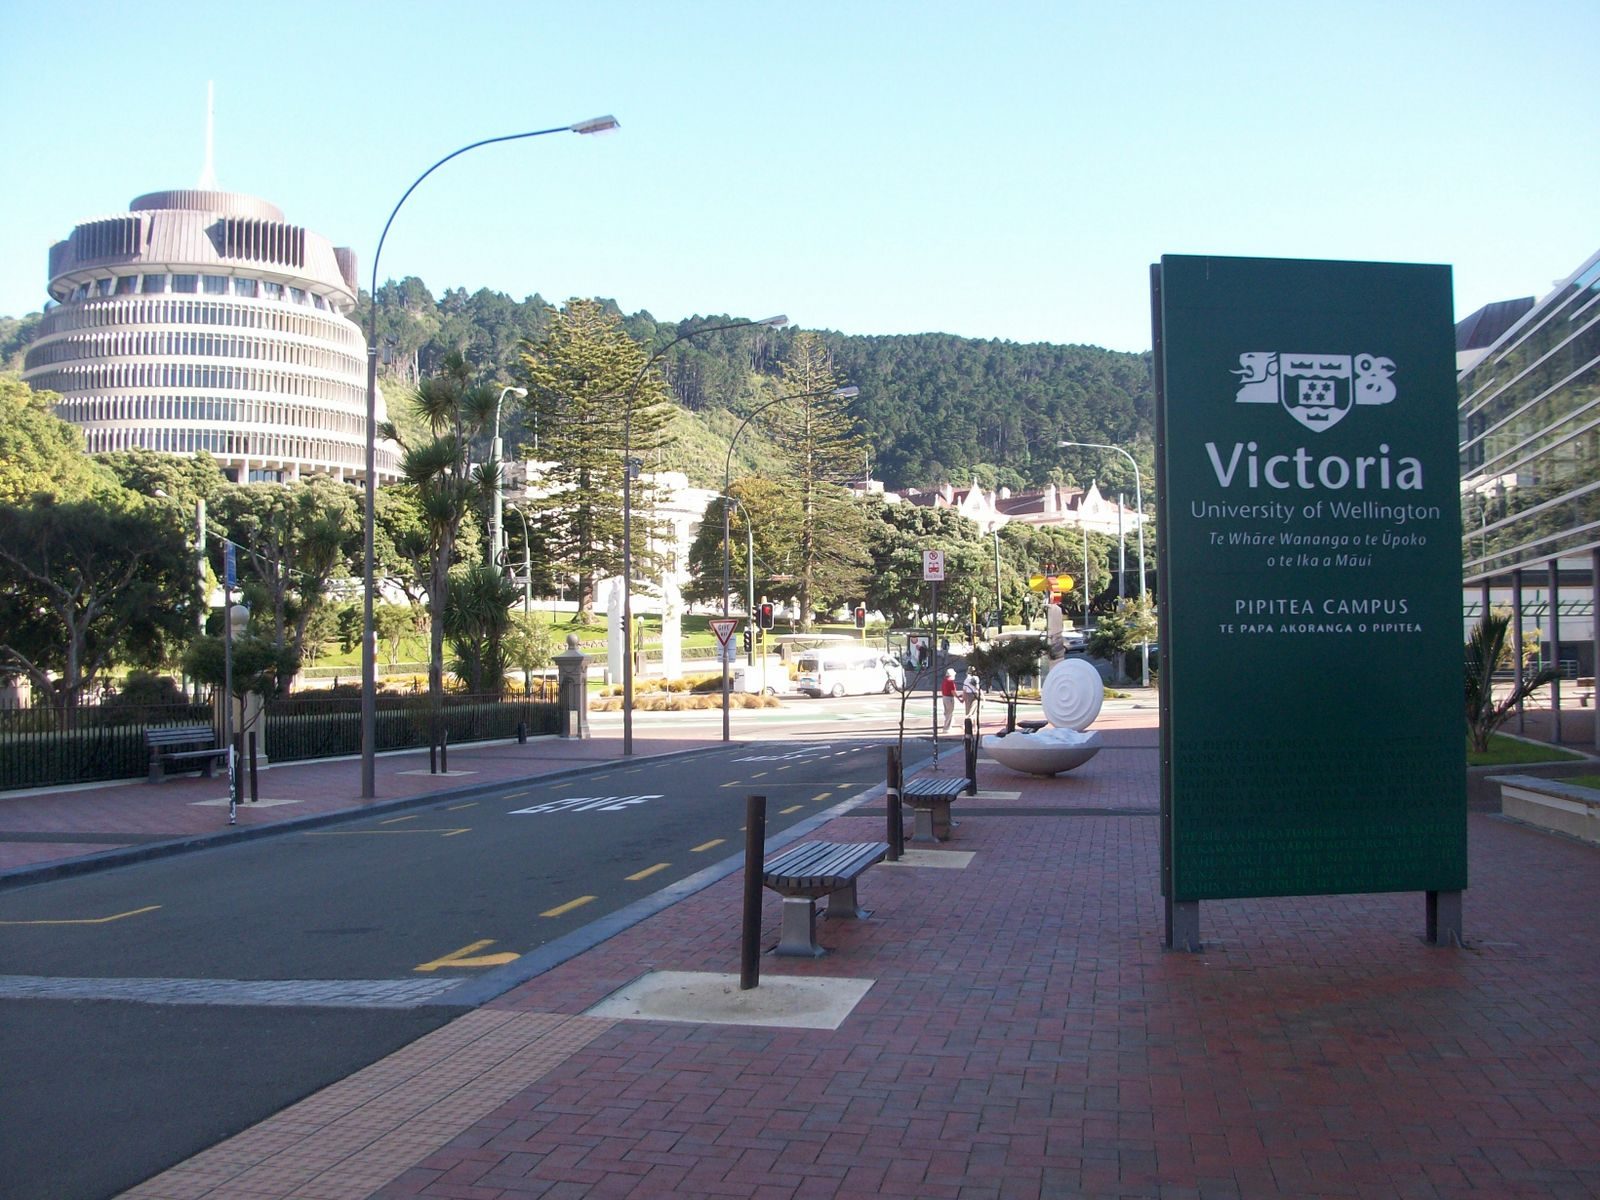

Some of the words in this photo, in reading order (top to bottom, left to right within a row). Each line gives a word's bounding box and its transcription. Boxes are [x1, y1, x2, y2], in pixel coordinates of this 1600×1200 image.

[1205, 441, 1423, 490] Victoria
[1191, 500, 1295, 524] University
[1302, 500, 1323, 519] of
[1329, 500, 1440, 525] Wellington
[1209, 531, 1224, 545] Te
[1280, 532, 1349, 549] Wananga
[1353, 535, 1361, 546] o
[1365, 534, 1378, 546] te
[1382, 529, 1427, 549] Ūpoko
[1267, 556, 1275, 567] o
[1279, 554, 1293, 567] te
[1297, 554, 1319, 567] Ika
[1323, 557, 1332, 567] a
[1335, 553, 1373, 567] Māui
[1235, 599, 1314, 615] PIPITEA
[1323, 599, 1408, 615] CAMPUS
[1219, 624, 1234, 633] TE
[1240, 624, 1274, 633] PAPA
[1280, 624, 1353, 633] AKORANGA
[1358, 623, 1367, 633] O
[1373, 623, 1422, 632] PIPITEA
